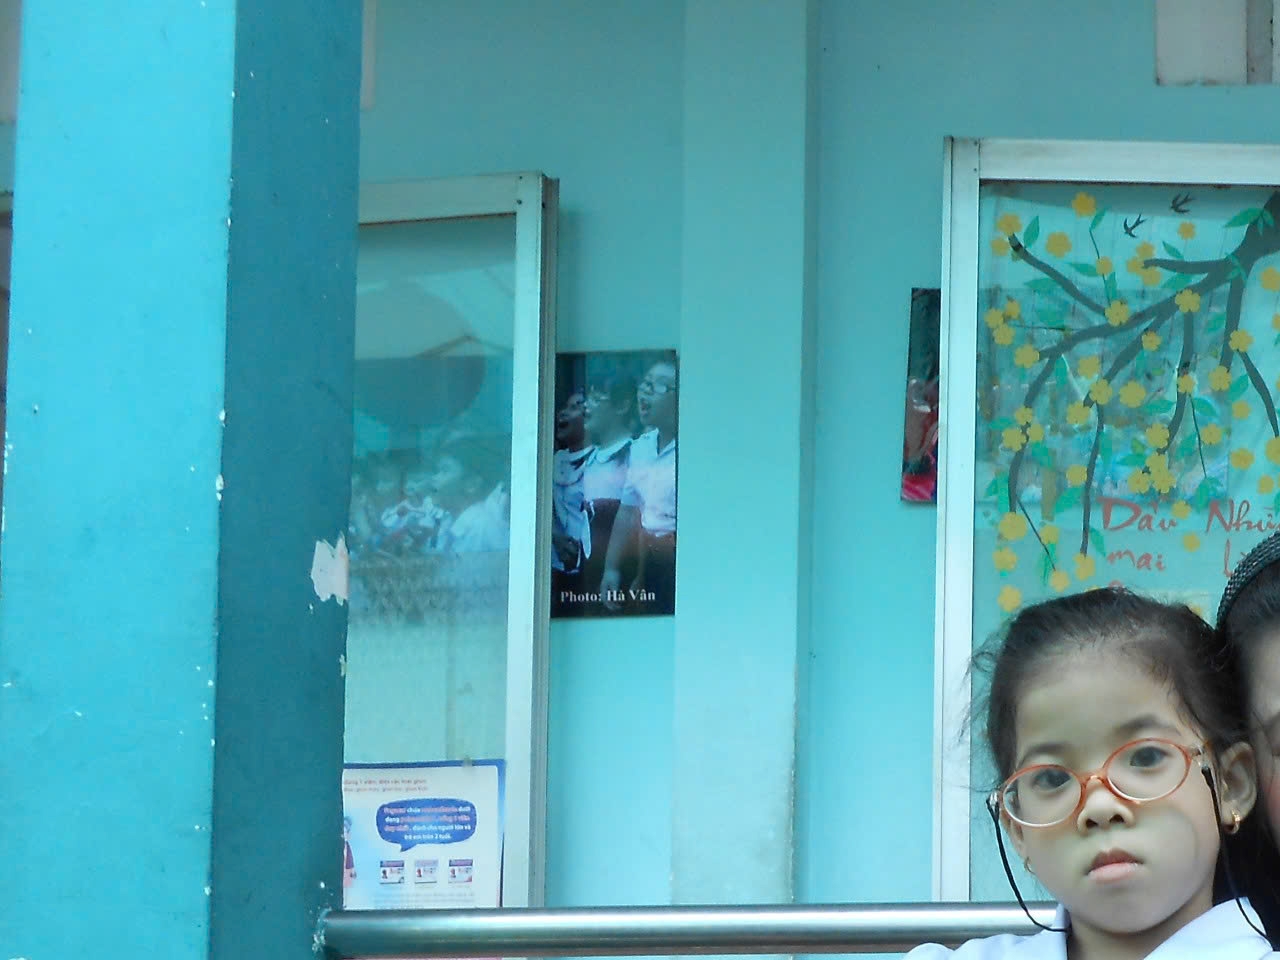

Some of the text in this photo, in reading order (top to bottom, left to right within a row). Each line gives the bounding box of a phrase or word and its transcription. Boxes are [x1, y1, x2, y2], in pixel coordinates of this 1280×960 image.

[1106, 548, 1167, 572] mai
[560, 588, 656, 603] Photo: Hà Vân
